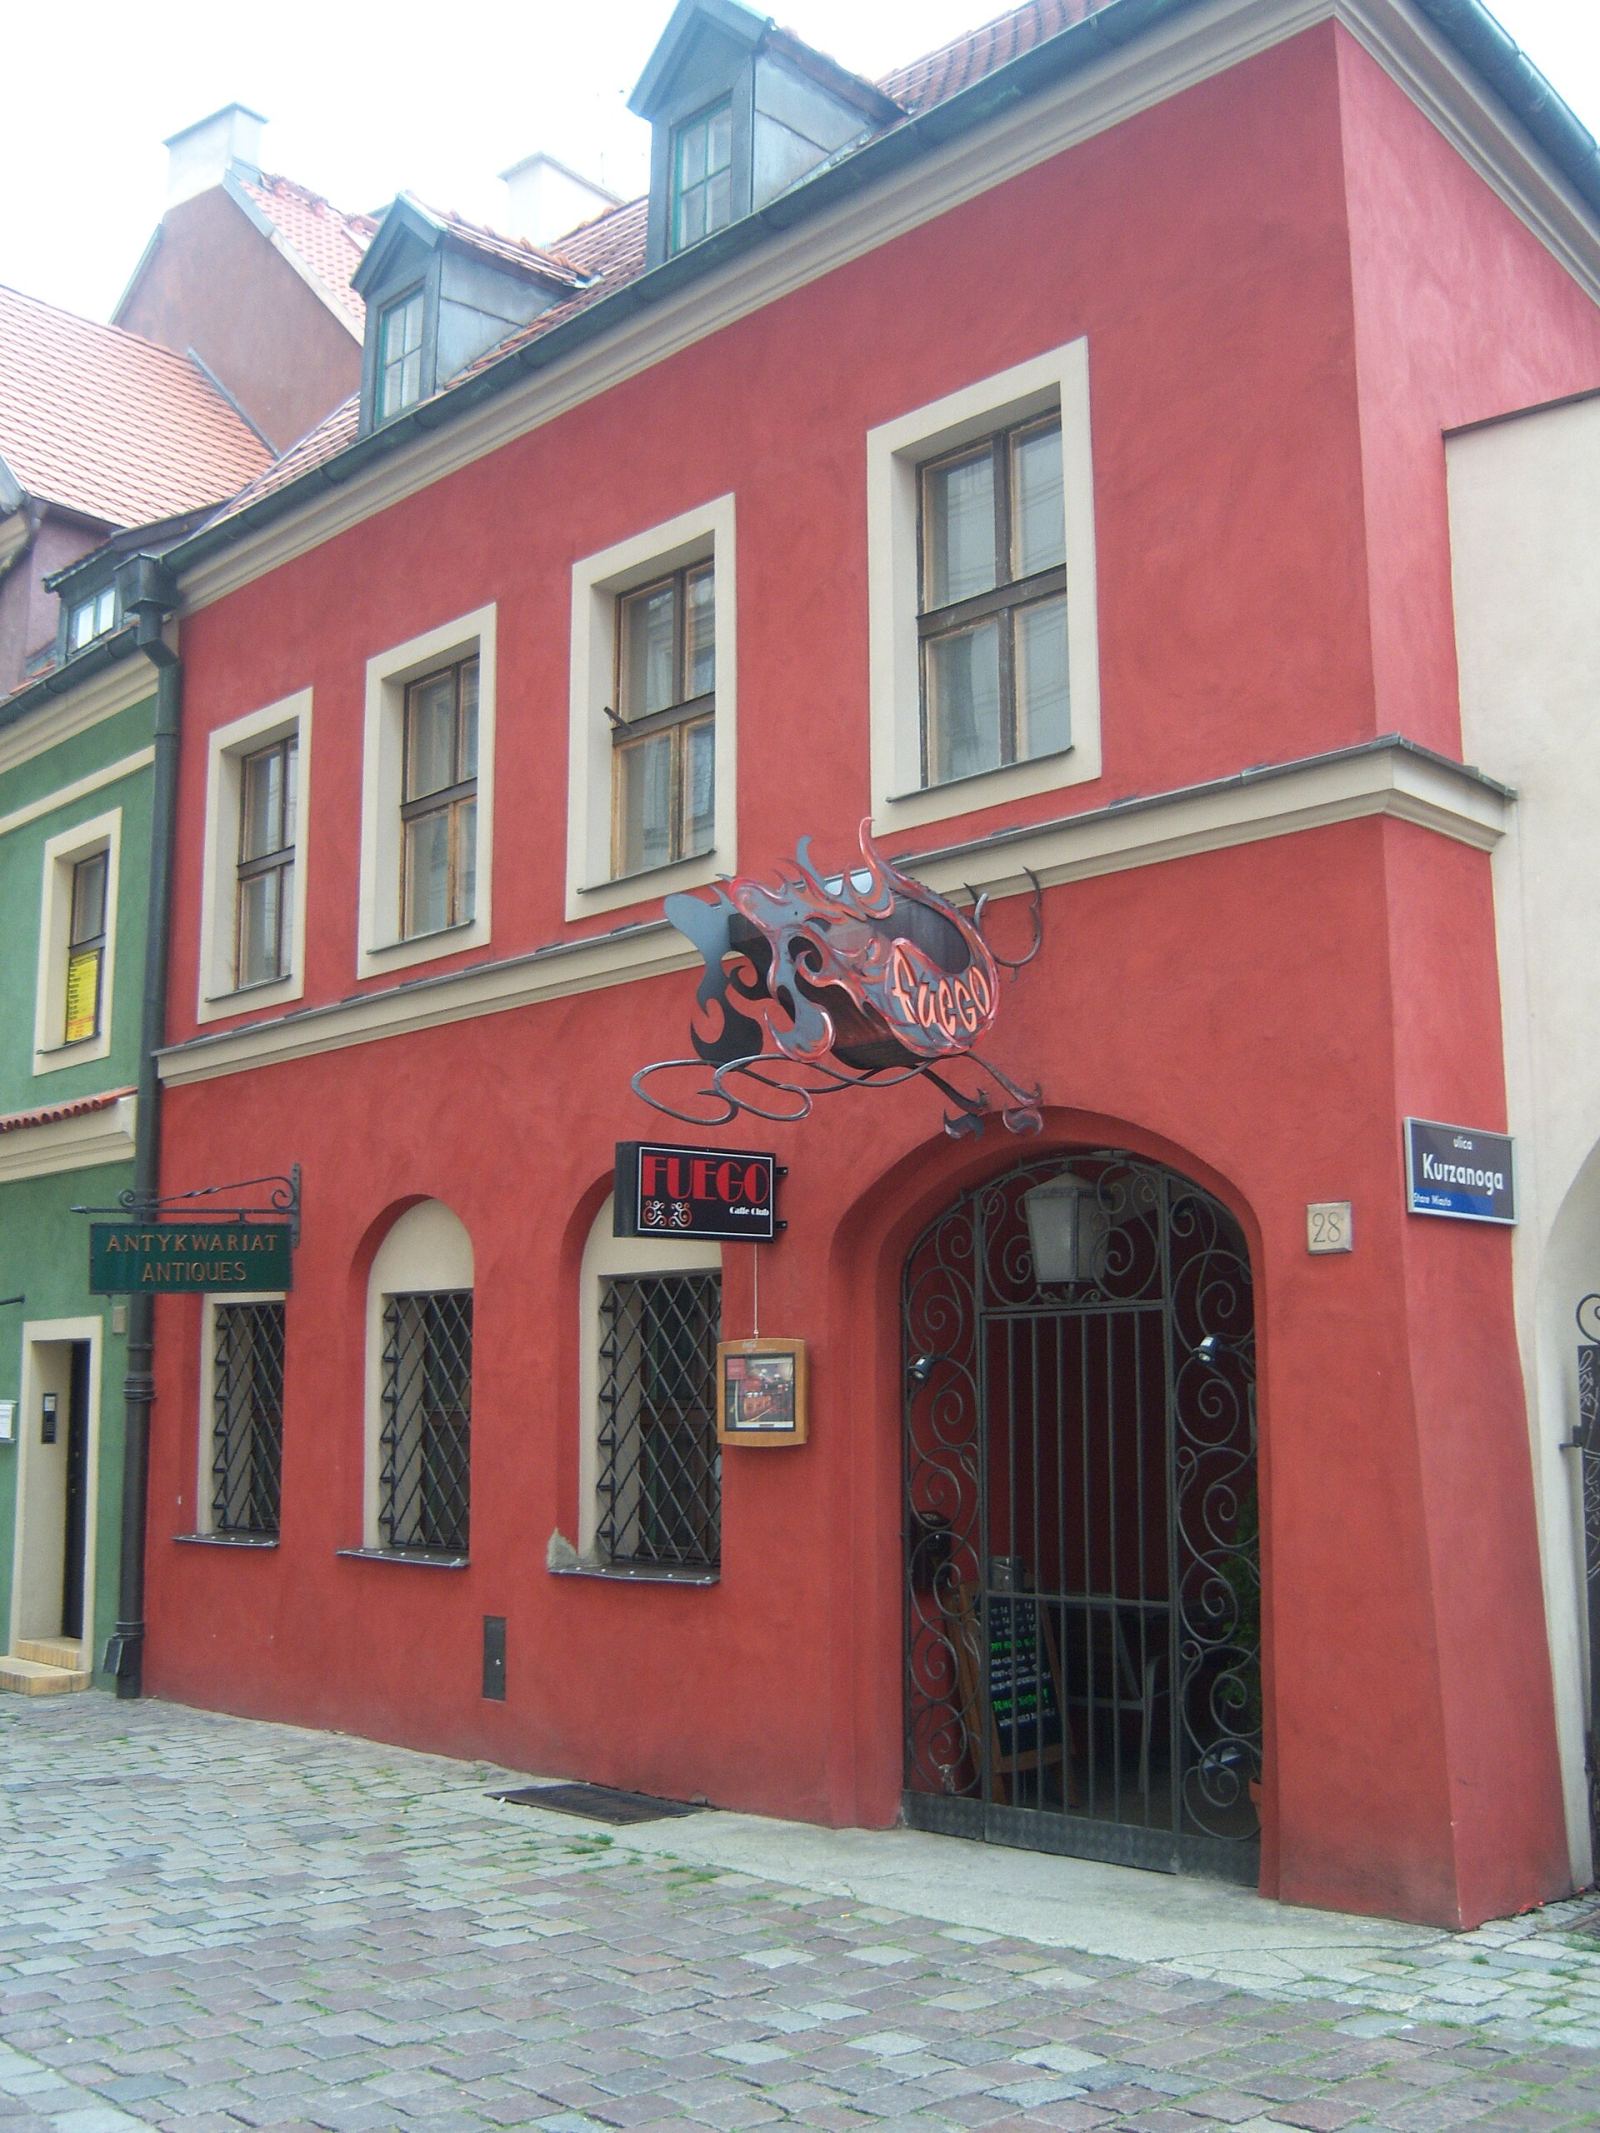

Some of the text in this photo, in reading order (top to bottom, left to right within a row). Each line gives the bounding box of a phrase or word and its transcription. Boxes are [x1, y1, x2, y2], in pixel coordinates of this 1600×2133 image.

[1453, 1136, 1473, 1150] ulica
[642, 1155, 770, 1205] FUEGO
[1422, 1153, 1504, 1195] Kurzanoga
[1414, 1192, 1430, 1204] Stare
[729, 1206, 770, 1216] Caffe Club
[1312, 1212, 1341, 1243] 28
[106, 1234, 278, 1253] ANTYKWARIAT
[141, 1261, 247, 1282] ANTIQUES
